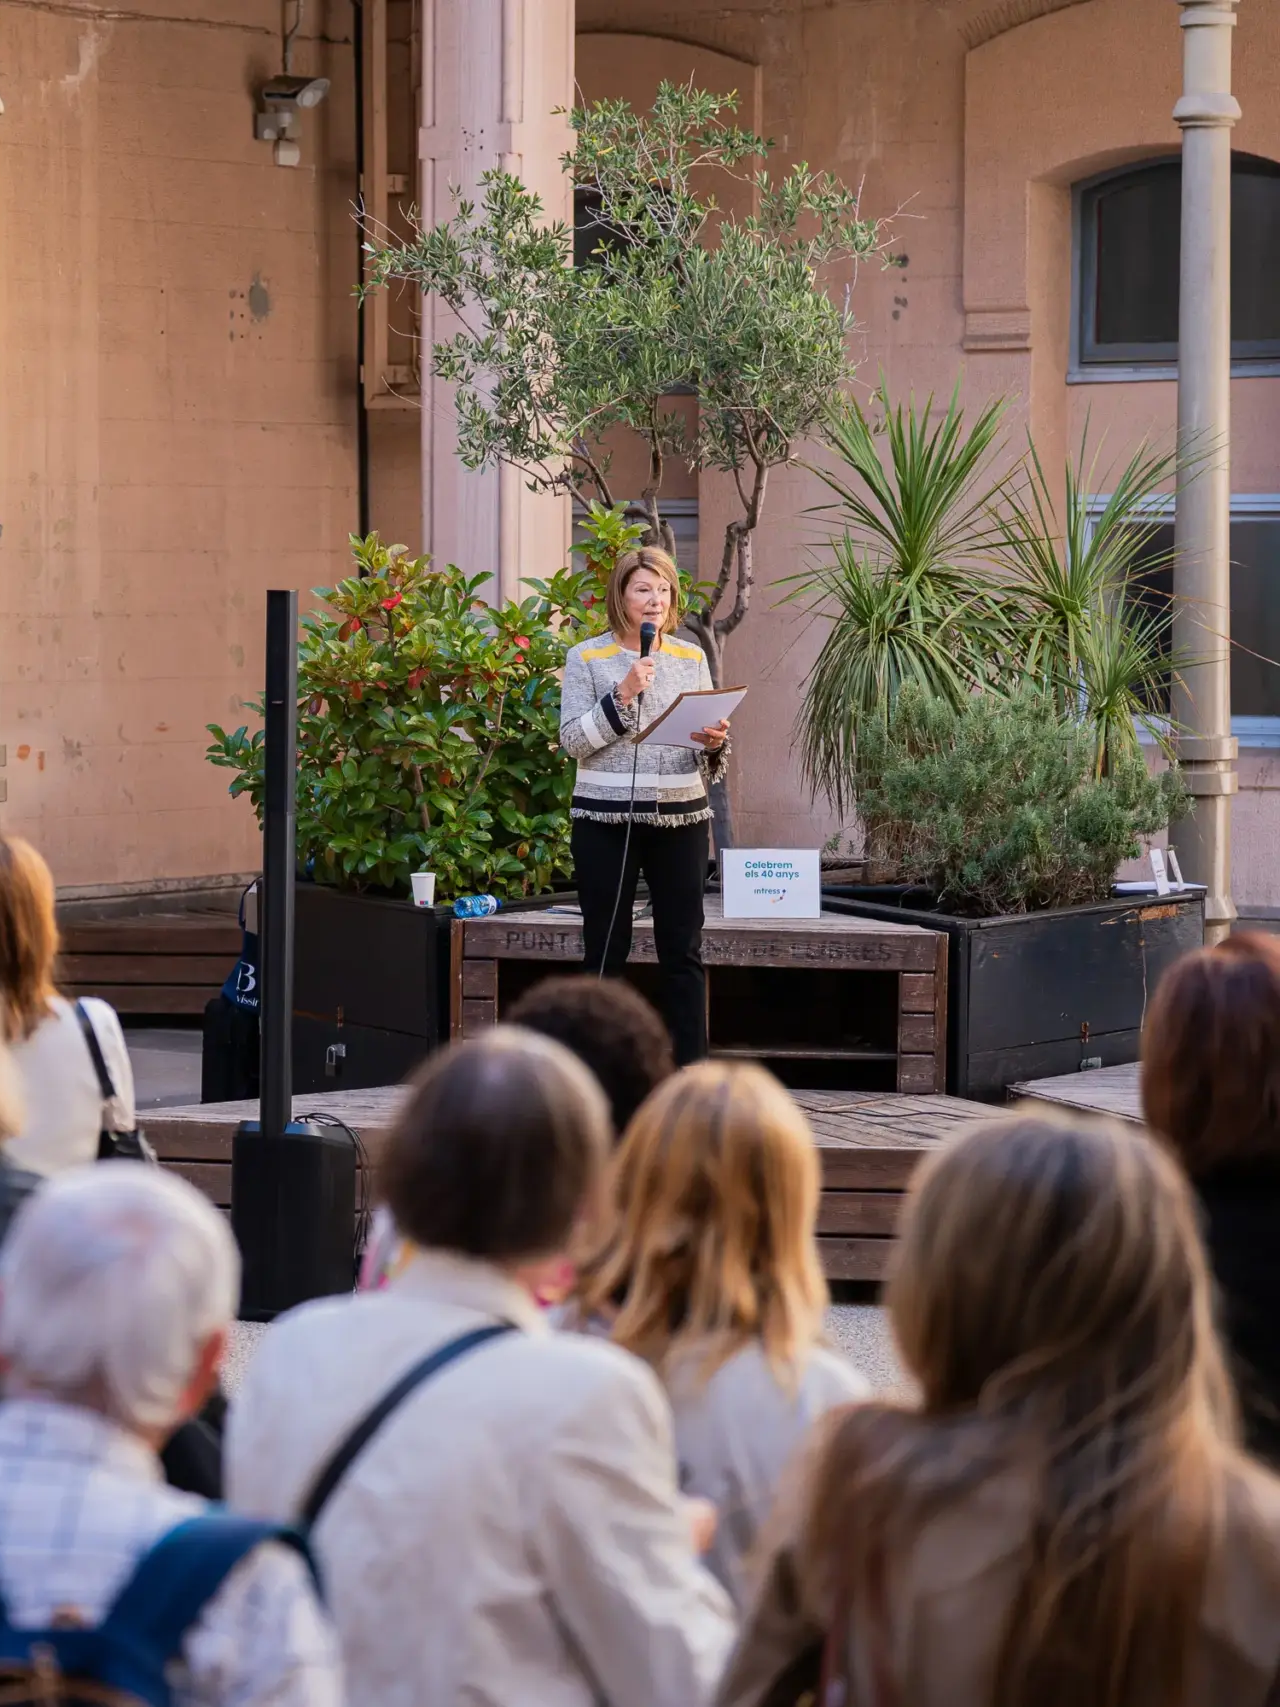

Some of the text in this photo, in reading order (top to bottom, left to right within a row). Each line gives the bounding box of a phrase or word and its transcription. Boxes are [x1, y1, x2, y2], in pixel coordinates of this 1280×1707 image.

[744, 861, 793, 869] Celebrem
[744, 869, 800, 880] els 40 anys
[753, 887, 781, 895] intress
[506, 931, 569, 950] PUNT
